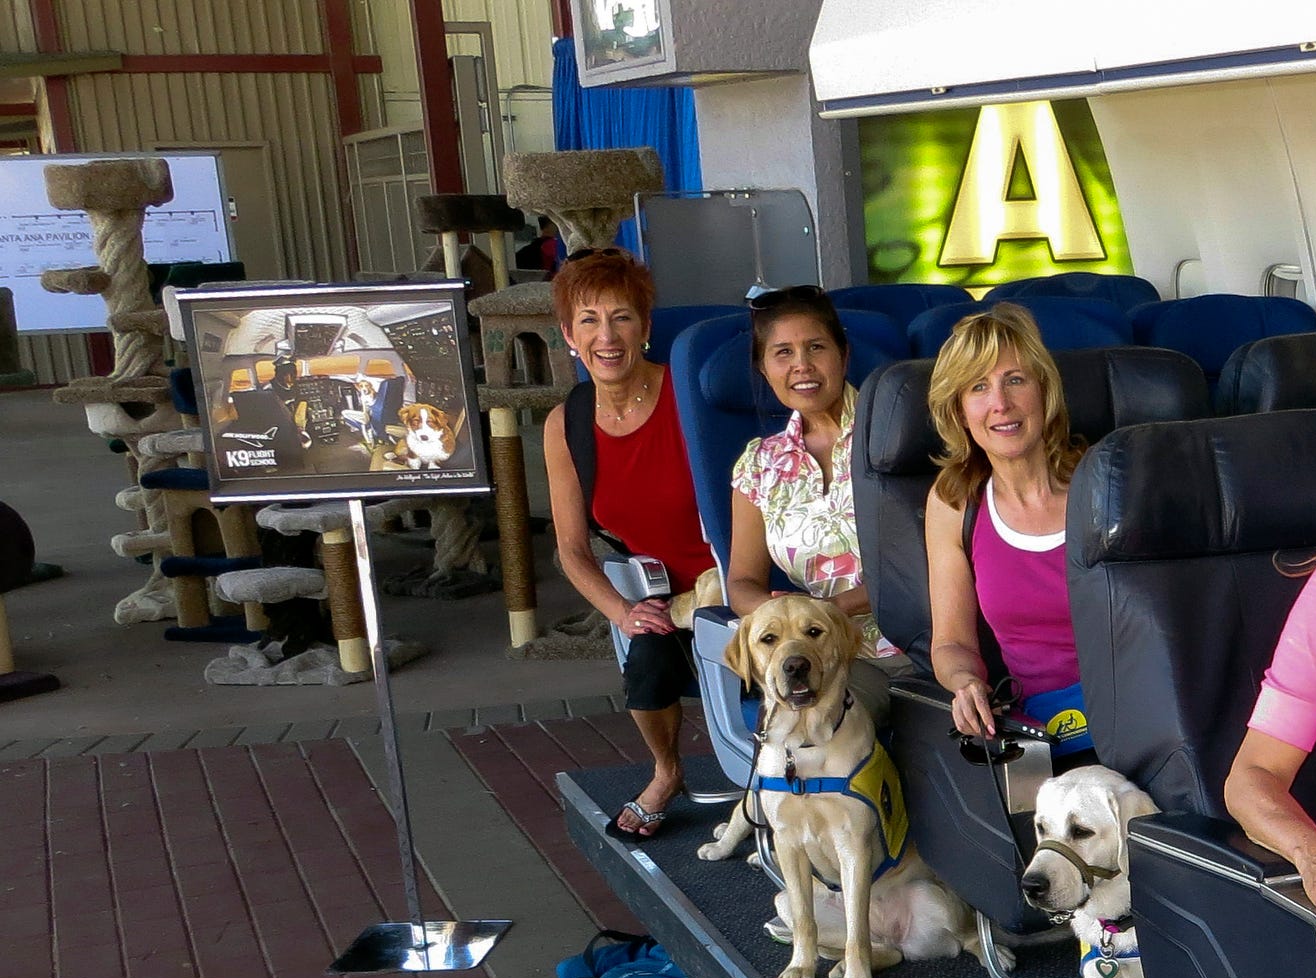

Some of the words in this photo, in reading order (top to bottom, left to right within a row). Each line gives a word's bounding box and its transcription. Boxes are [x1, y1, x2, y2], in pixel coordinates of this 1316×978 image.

[937, 101, 1106, 266] A
[24, 233, 44, 241] ANA
[46, 232, 90, 241] PAVILION
[226, 450, 249, 467] K9
[249, 449, 275, 458] FLIGHT
